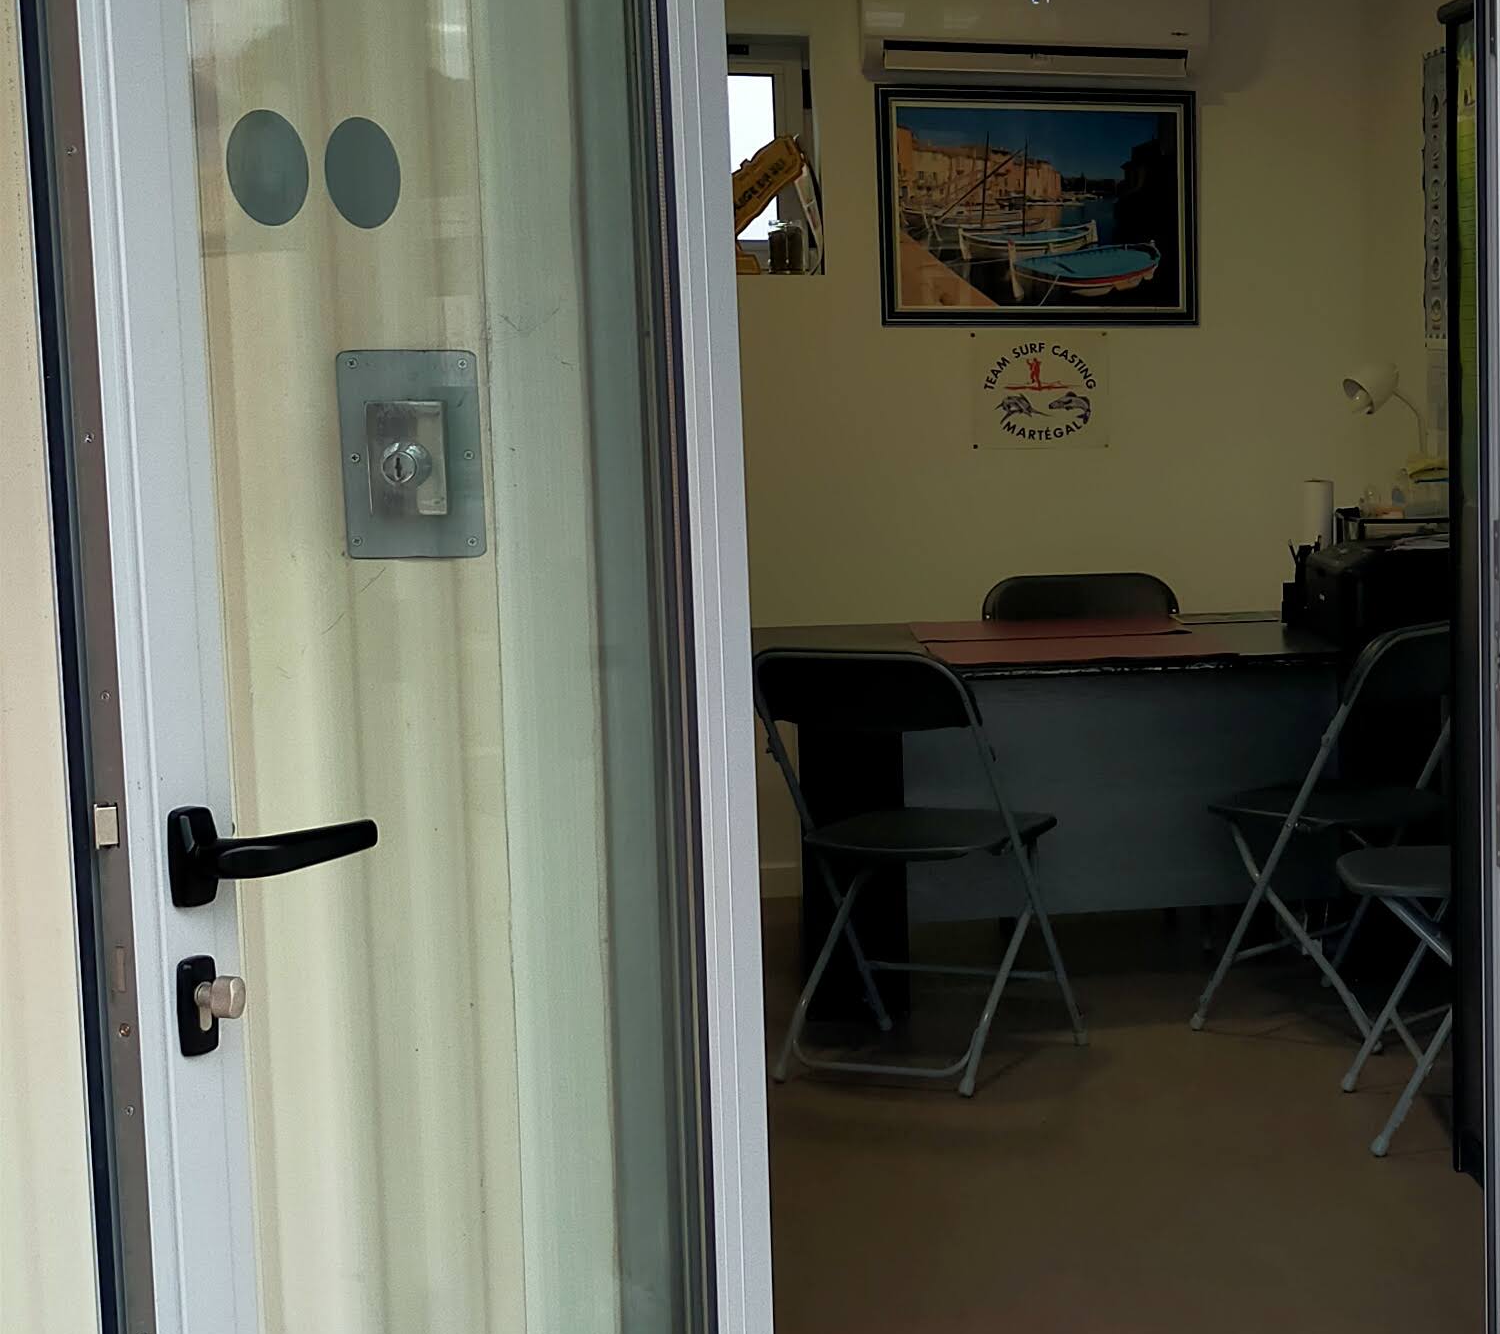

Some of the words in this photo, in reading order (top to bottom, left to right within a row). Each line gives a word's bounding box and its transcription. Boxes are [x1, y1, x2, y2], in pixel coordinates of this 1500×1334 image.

[983, 356, 1010, 391] TEAM
[1012, 342, 1046, 359] SURF
[1051, 345, 1097, 390] CASTING
[1002, 420, 1083, 441] MARTÉGAL
